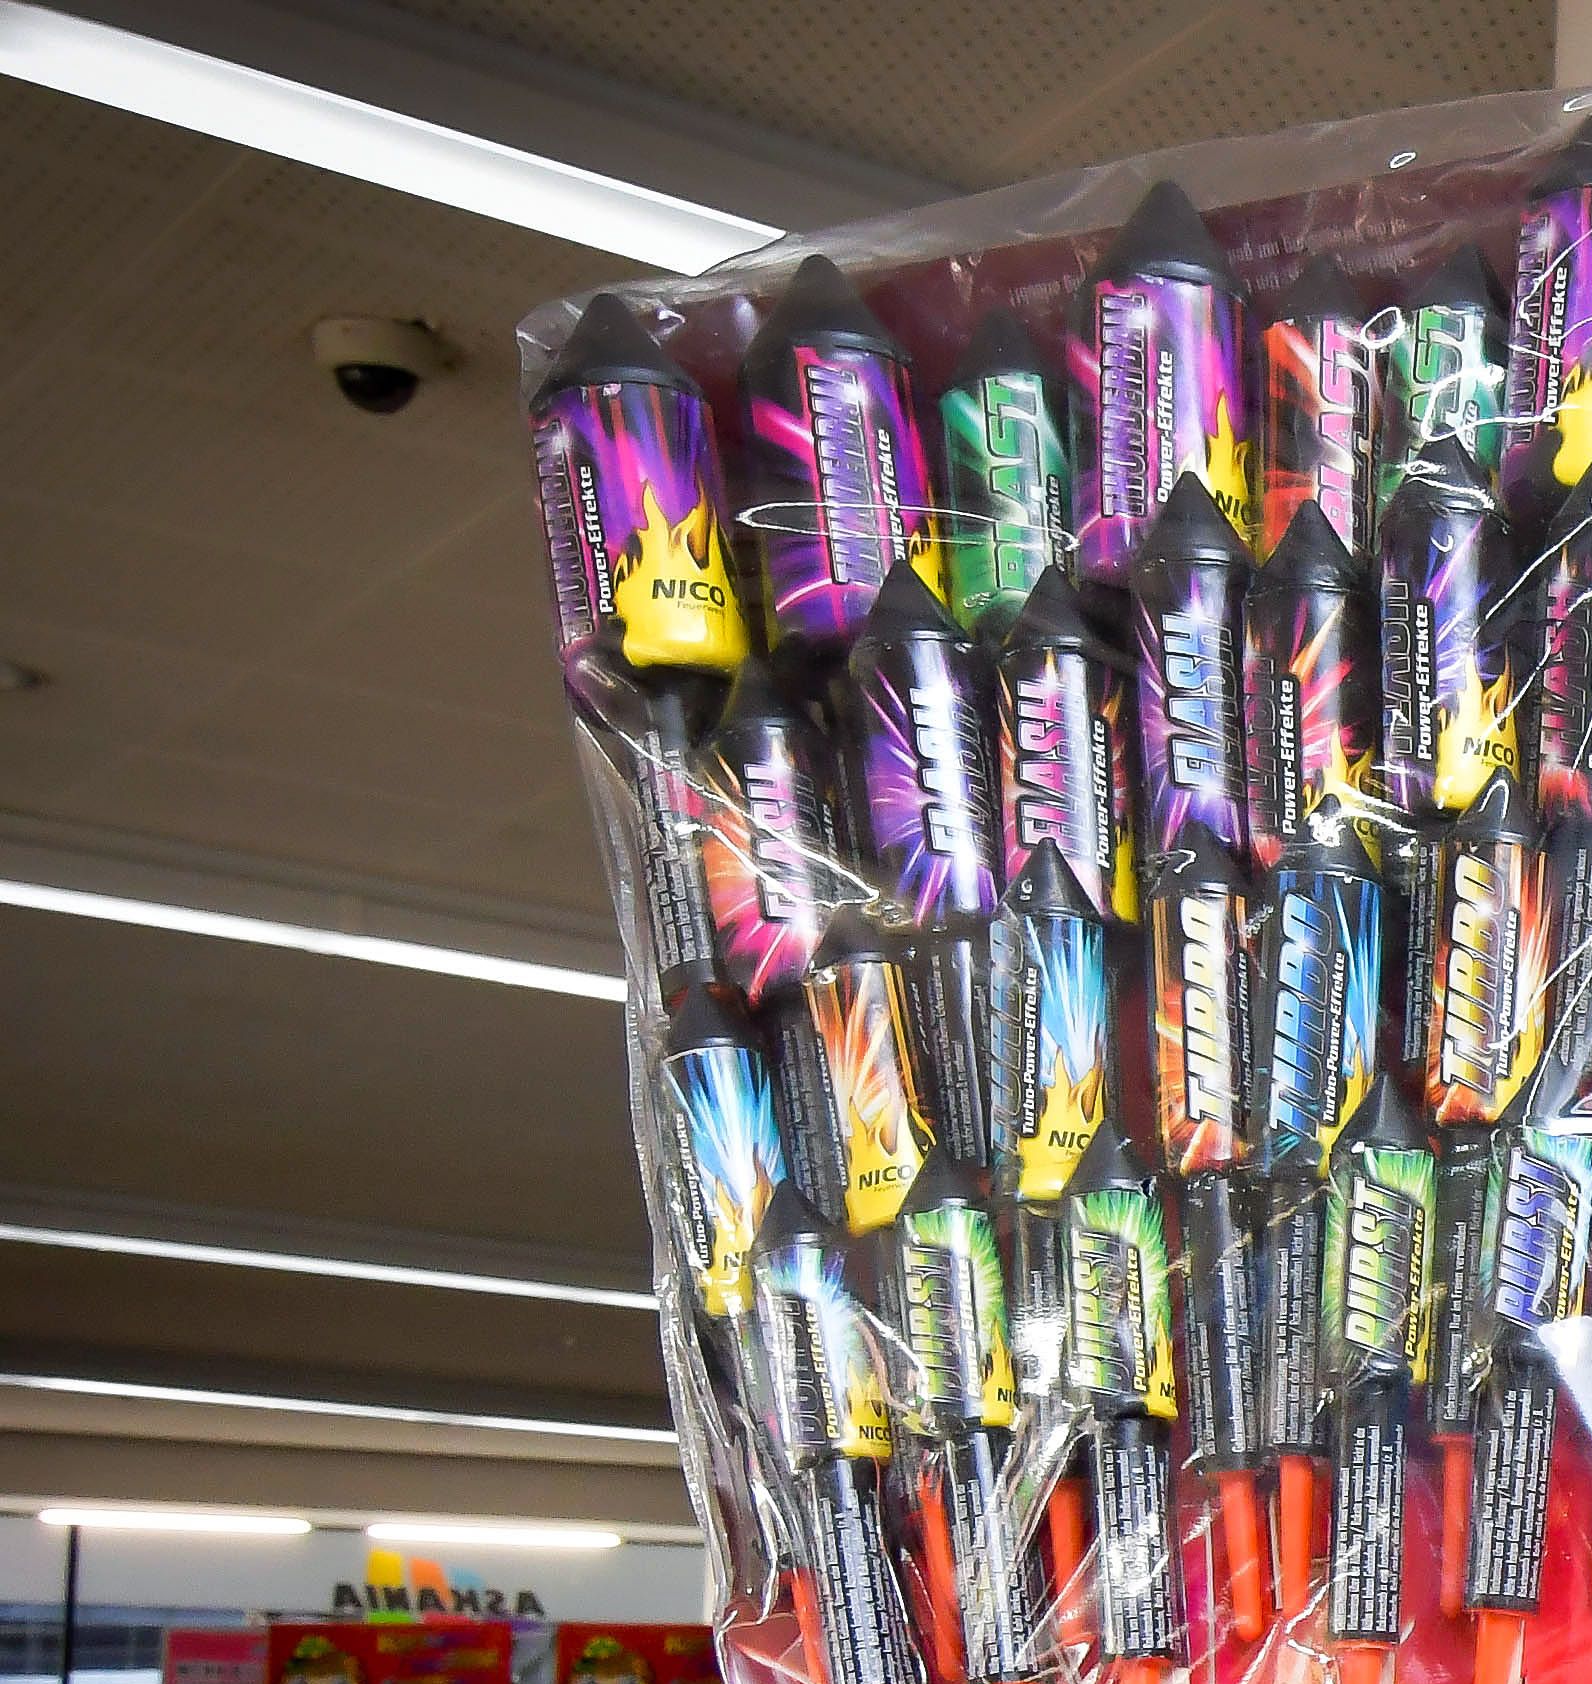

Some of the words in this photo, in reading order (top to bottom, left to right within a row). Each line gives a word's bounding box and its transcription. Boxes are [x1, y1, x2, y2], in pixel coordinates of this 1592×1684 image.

[580, 466, 615, 613] Power-Effekte
[651, 578, 726, 607] NICO
[1162, 610, 1243, 802] FLASH
[1282, 679, 1296, 836] Power-Effekte
[1415, 604, 1430, 760] Power-Effekte
[1094, 719, 1112, 868] Power-Effekte
[1023, 967, 1039, 1135] Turbo-Power-Effekte
[1181, 896, 1237, 1127] TURBO
[1271, 892, 1336, 1139] TURBO
[1322, 952, 1346, 1124] Turbo-Power-Effekte
[1441, 852, 1507, 1094] TURBO
[859, 1165, 914, 1190] NICO
[1345, 1177, 1411, 1358] BURST
[1403, 1207, 1426, 1358] Power-Effekte
